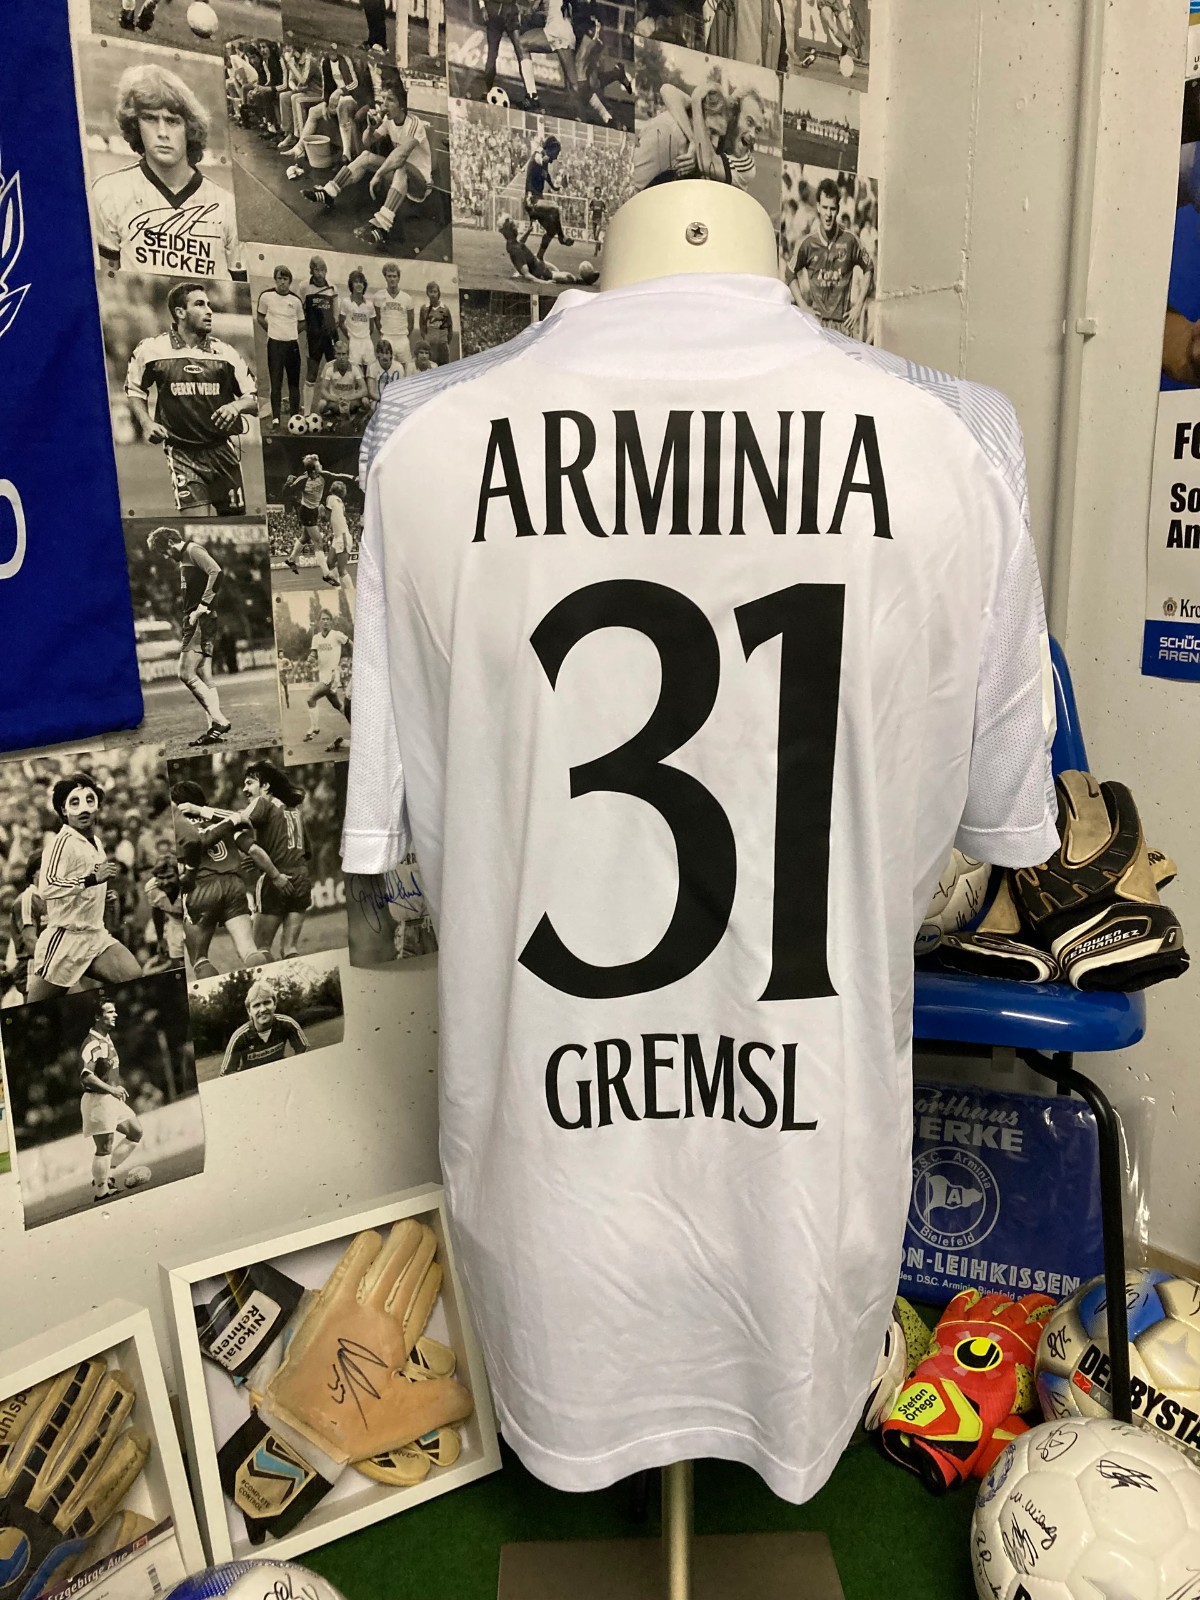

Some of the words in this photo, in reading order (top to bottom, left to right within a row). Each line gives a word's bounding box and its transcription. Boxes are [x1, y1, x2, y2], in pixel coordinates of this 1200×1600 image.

[135, 247, 216, 275] STICKER
[143, 229, 211, 258] SEIDEN
[171, 383, 196, 396] GERRY
[472, 411, 893, 541] ARMINIA
[518, 579, 846, 1001] 31
[545, 1035, 818, 1131] GREMSL
[913, 1116, 1024, 1152] ERKE
[953, 1152, 991, 1189] Arminia
[920, 1226, 976, 1247] Bielefeld
[212, 1303, 260, 1356] Rehnen
[222, 1312, 267, 1363] Nikolai
[897, 1388, 929, 1416] Stefan
[905, 1393, 938, 1421] Ortega
